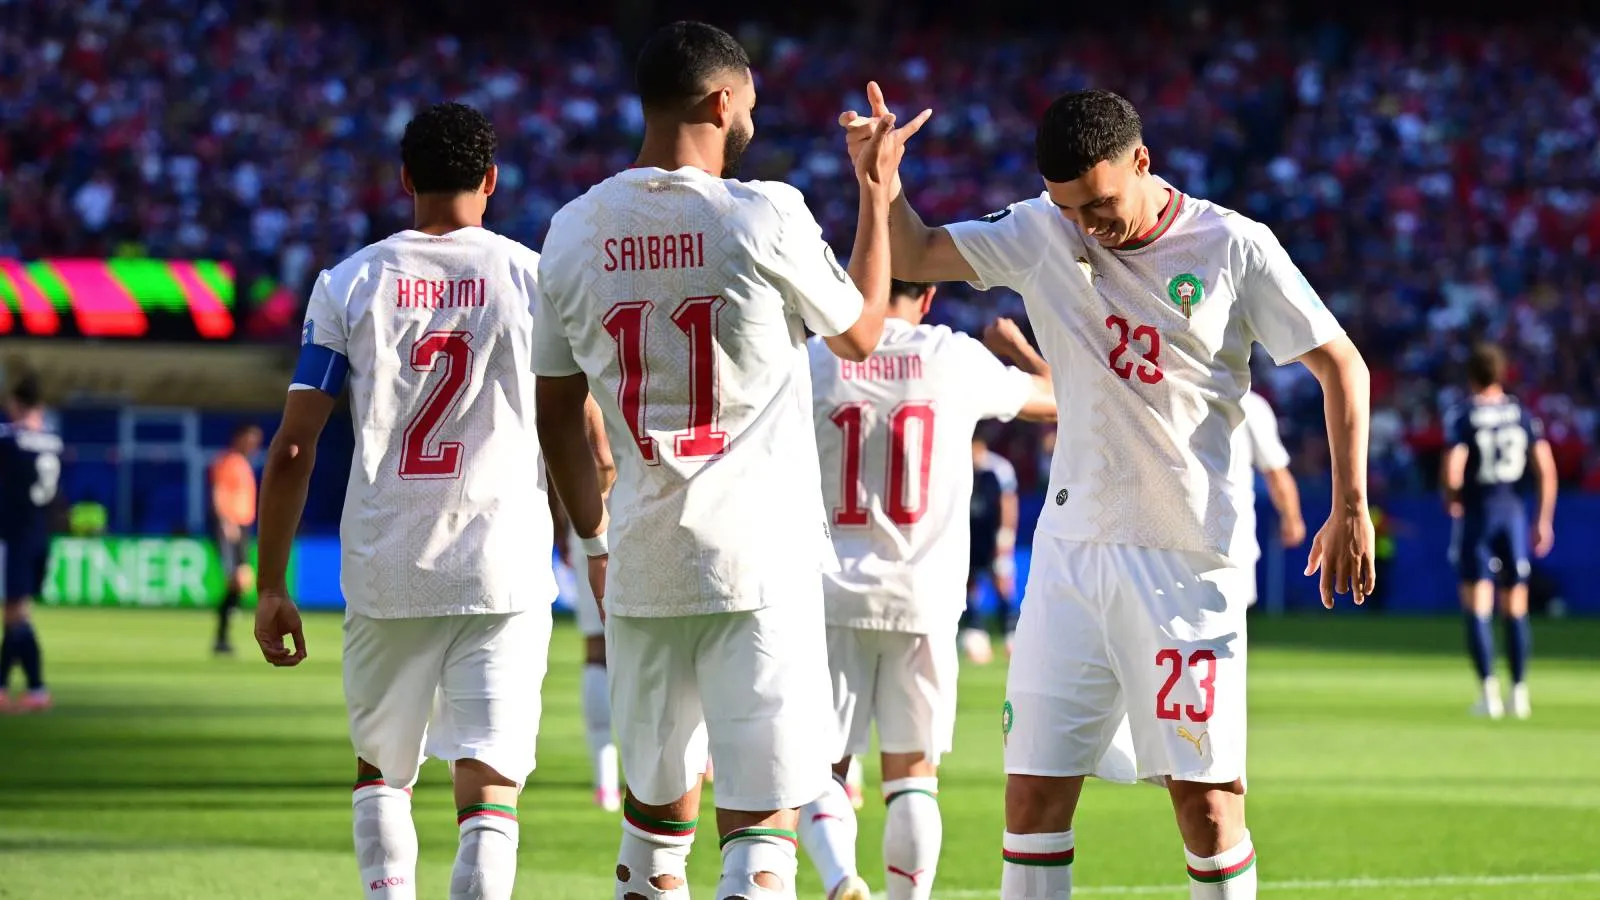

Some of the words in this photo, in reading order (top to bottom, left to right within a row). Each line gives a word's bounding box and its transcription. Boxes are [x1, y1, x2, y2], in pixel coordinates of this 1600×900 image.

[604, 233, 704, 272] SAIBARI
[396, 278, 486, 309] HAKIMI
[602, 295, 730, 467] 11
[1105, 314, 1164, 384] 23
[399, 331, 474, 480] 2
[829, 400, 937, 530] 10
[1474, 424, 1528, 484] 13
[1155, 649, 1217, 722] 23
